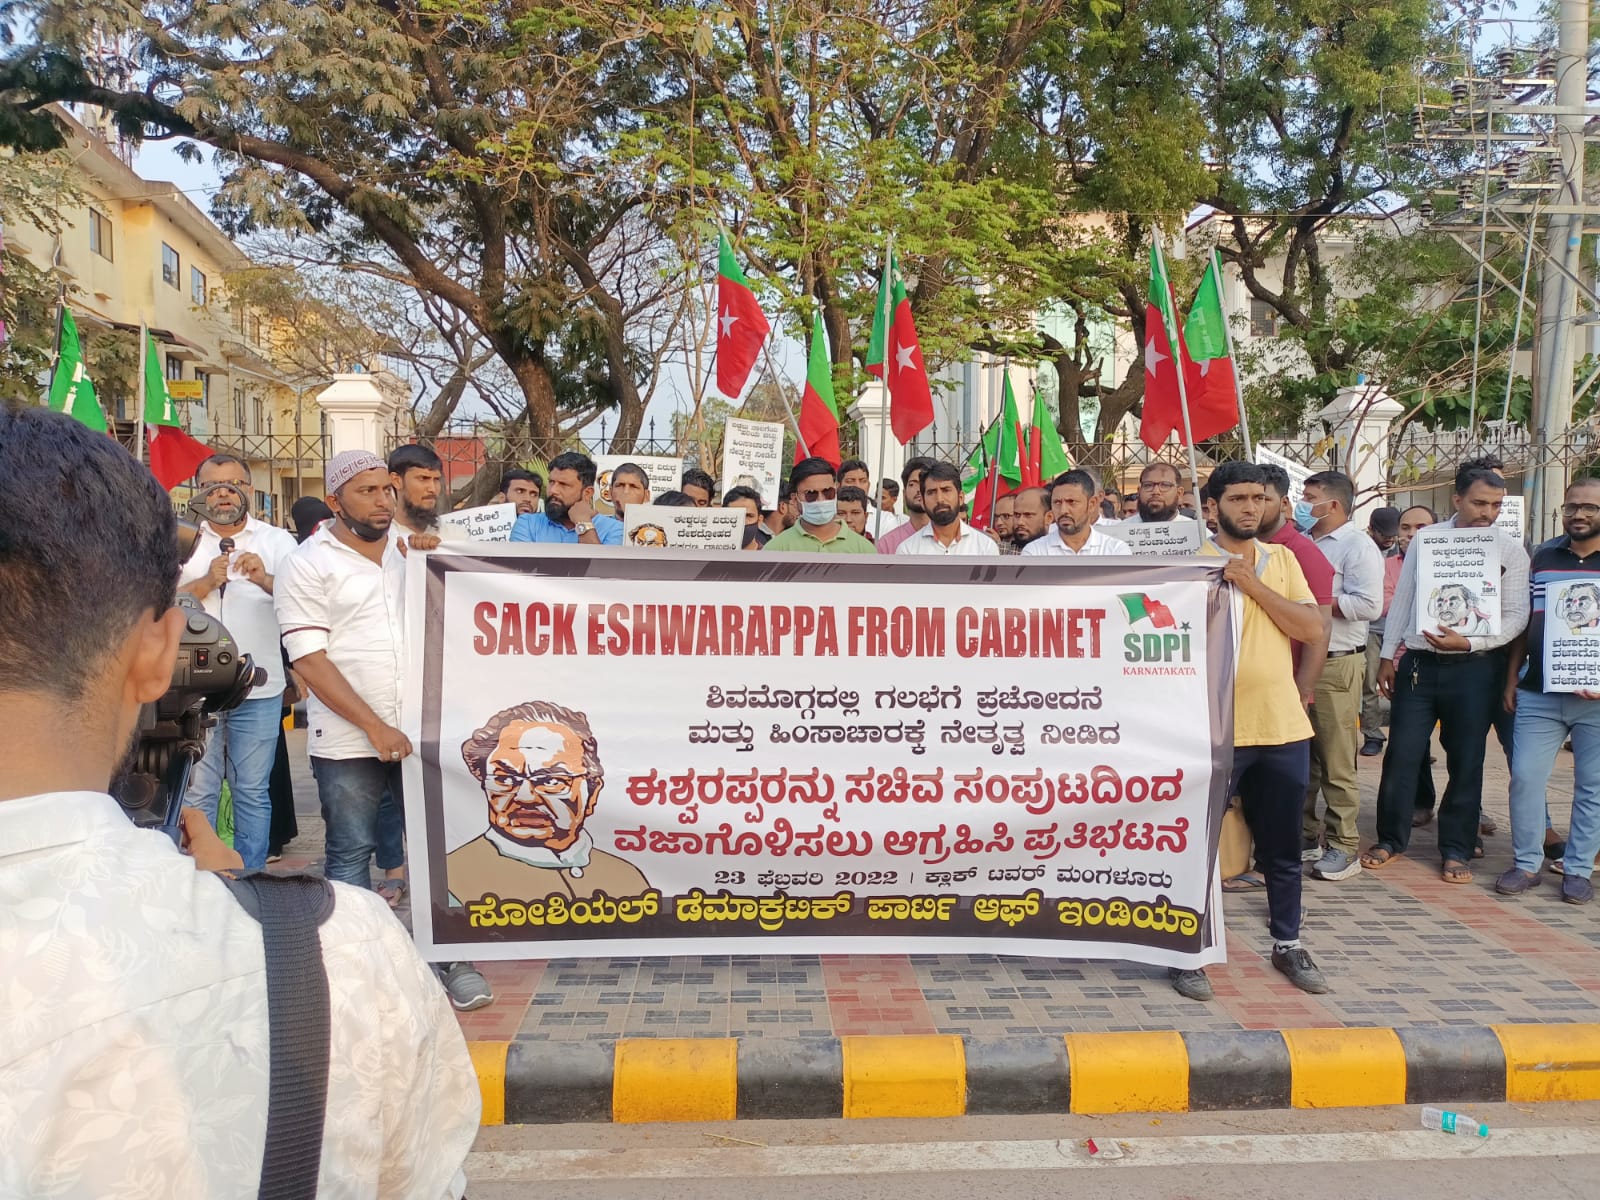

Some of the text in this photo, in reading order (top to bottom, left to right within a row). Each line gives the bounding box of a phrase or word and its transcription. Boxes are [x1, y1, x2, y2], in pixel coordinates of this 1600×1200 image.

[472, 601, 1106, 659] SACK ESHWARAPPA FROM CABINET
[1123, 633, 1191, 662] SDPI
[1123, 666, 1197, 676] KARNATAKATA
[706, 684, 1103, 720] ಶಿವಮೊಗ್ಗದಲ್ಲಿ ಗಲಭೆಗೆ ಪ್ರಚೋದನೆ
[688, 719, 1121, 755] ಮತ್ತು ಹಿಂಸಾಚಾರಕ್ಕೆ ನೇತೃತ್ವ ನೀಡಿದ
[625, 764, 1184, 824] ಈಶ್ವರಪ್ಪರನ್ನು ಸಚಿವ ಸಂಪುಟದಿಂದ
[614, 816, 1190, 865] ವಜಾಗೊಳಿಸಲು ಆಗ್ರಹಿಸಿ ಪ್ರತಿಭಟನೆ
[714, 870, 746, 885] 23
[757, 869, 824, 890] ಫೆಬ್ರವರಿ
[835, 871, 898, 886] 2022
[925, 866, 978, 887] ಕ್ಲಾಕ್
[988, 864, 1046, 882] ಟವರ್
[1057, 864, 1173, 889] ಮಂಗಳೂರು
[469, 891, 1199, 937] ಸೋಶಿಯಲ್ ಡೆಮಾಕ್ರಟಿಕ್ ಪಾರ್ಟಿ ಆಫ್ ಇಂಡಿಯಾ
